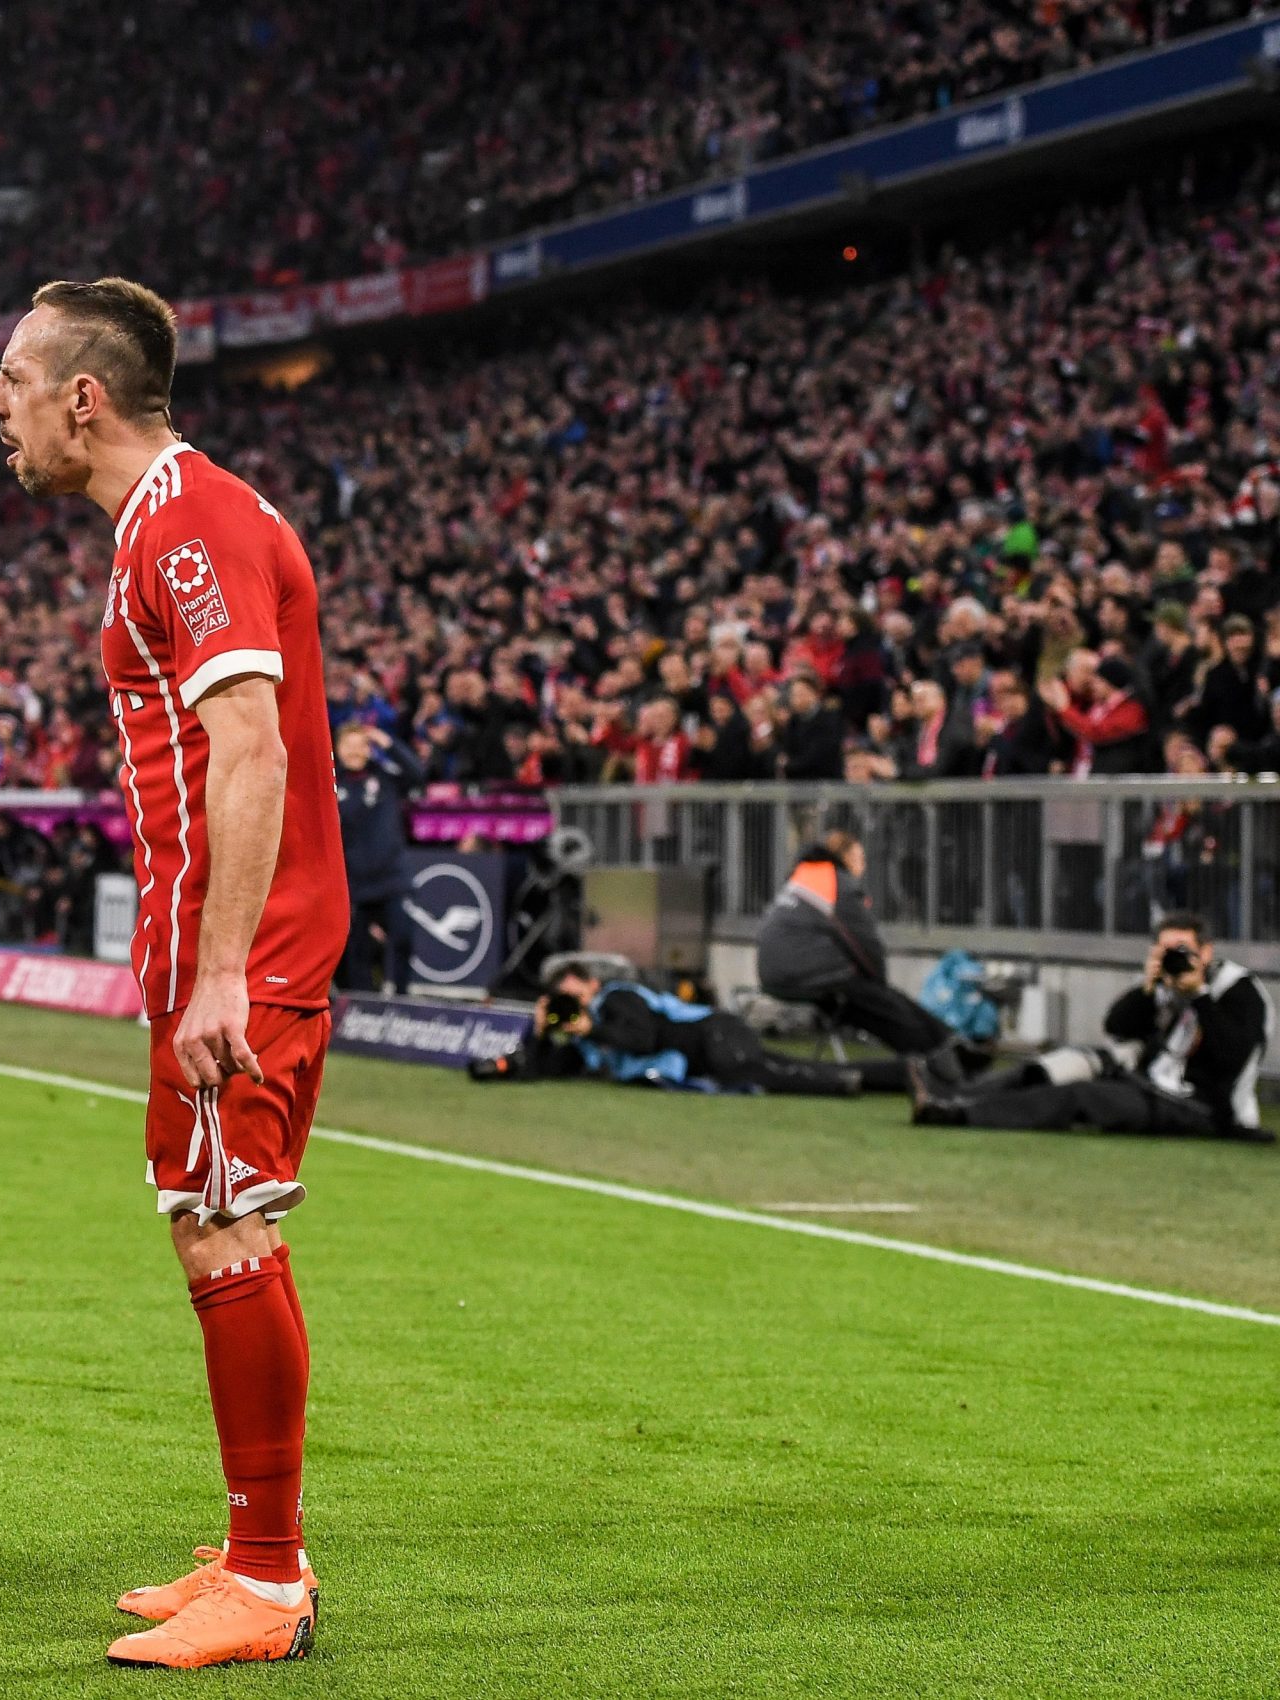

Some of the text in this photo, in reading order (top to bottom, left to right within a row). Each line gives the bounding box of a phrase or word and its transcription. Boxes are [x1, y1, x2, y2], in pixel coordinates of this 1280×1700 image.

[180, 583, 218, 614] Hamad
[188, 597, 221, 626] Airport
[227, 1493, 248, 1507] CB
